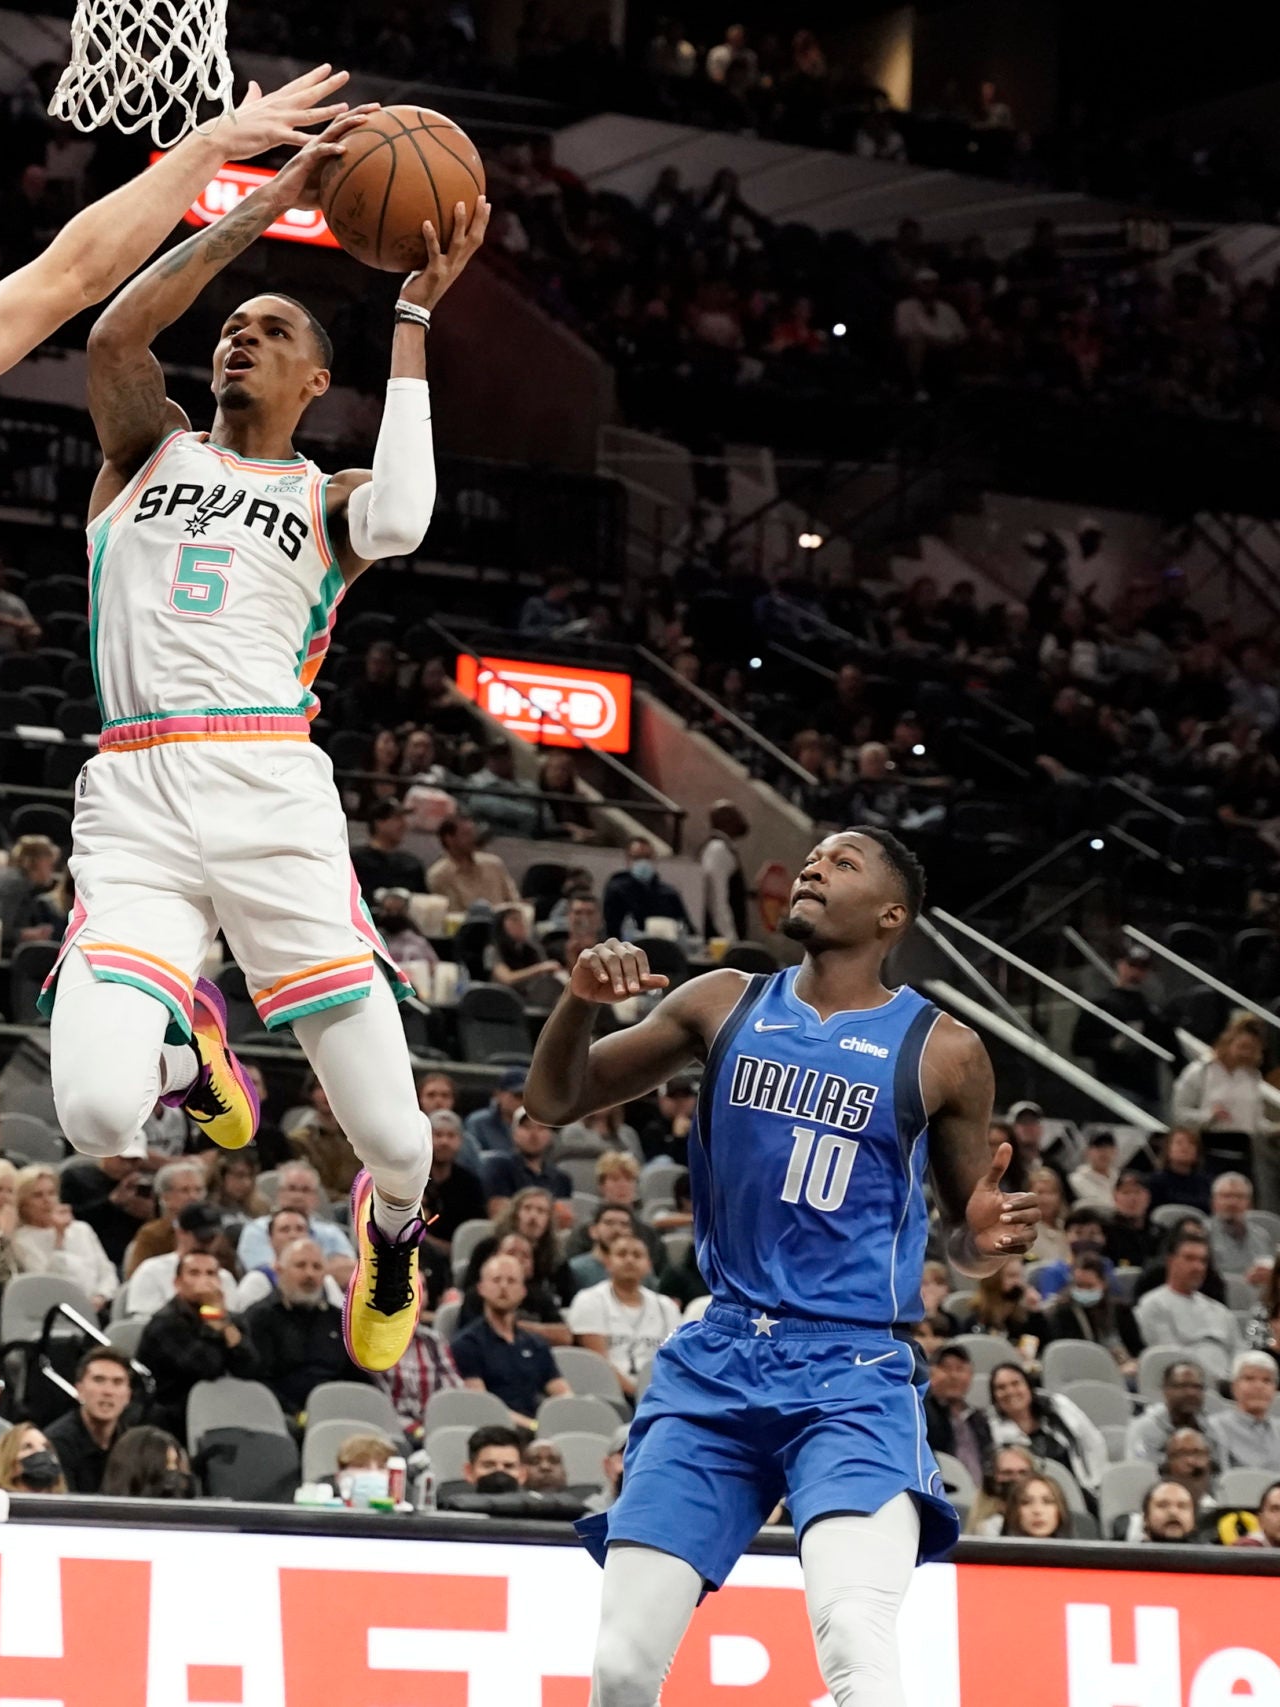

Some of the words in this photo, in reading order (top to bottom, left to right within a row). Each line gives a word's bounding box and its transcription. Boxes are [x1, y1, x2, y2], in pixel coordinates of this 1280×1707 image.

[134, 483, 309, 562] SPURS
[169, 542, 236, 617] 5
[839, 1036, 889, 1059] chime
[729, 1054, 879, 1132] DALLAS
[780, 1126, 859, 1212] 10
